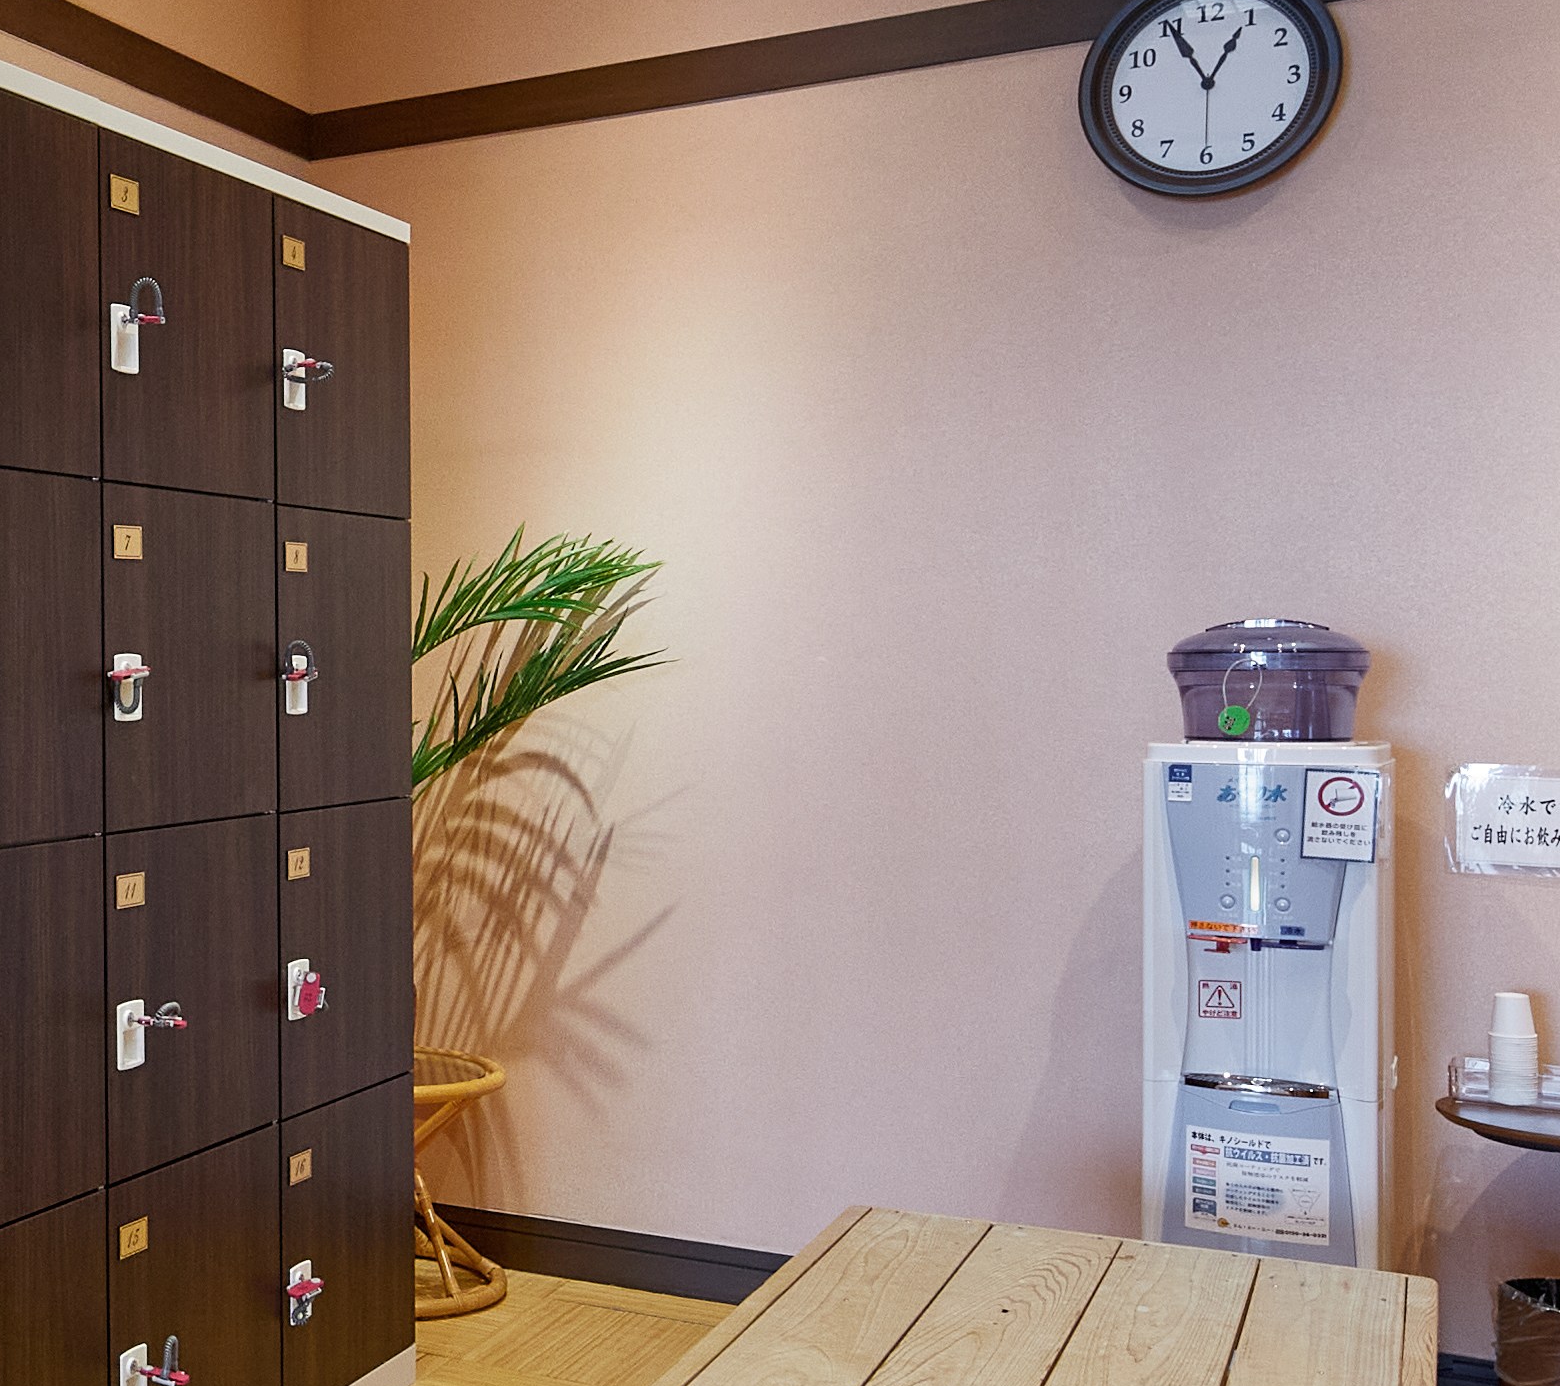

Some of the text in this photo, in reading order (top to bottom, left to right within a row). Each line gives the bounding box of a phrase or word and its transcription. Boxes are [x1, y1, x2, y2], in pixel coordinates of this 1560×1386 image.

[1197, 2, 1225, 24] 12
[1244, 8, 1257, 27] 1
[1274, 27, 1288, 47] 2
[1129, 48, 1156, 70] 10
[1287, 64, 1301, 84] 3
[1119, 85, 1132, 103] 9
[1271, 103, 1286, 121] 4
[1131, 119, 1144, 137] 8
[1160, 140, 1174, 158] 7
[1241, 133, 1255, 152] 5
[1199, 145, 1213, 164] 6
[293, 855, 304, 872] 12
[125, 883, 137, 898] 11
[295, 1159, 306, 1176] 16
[127, 1228, 140, 1246] 15
